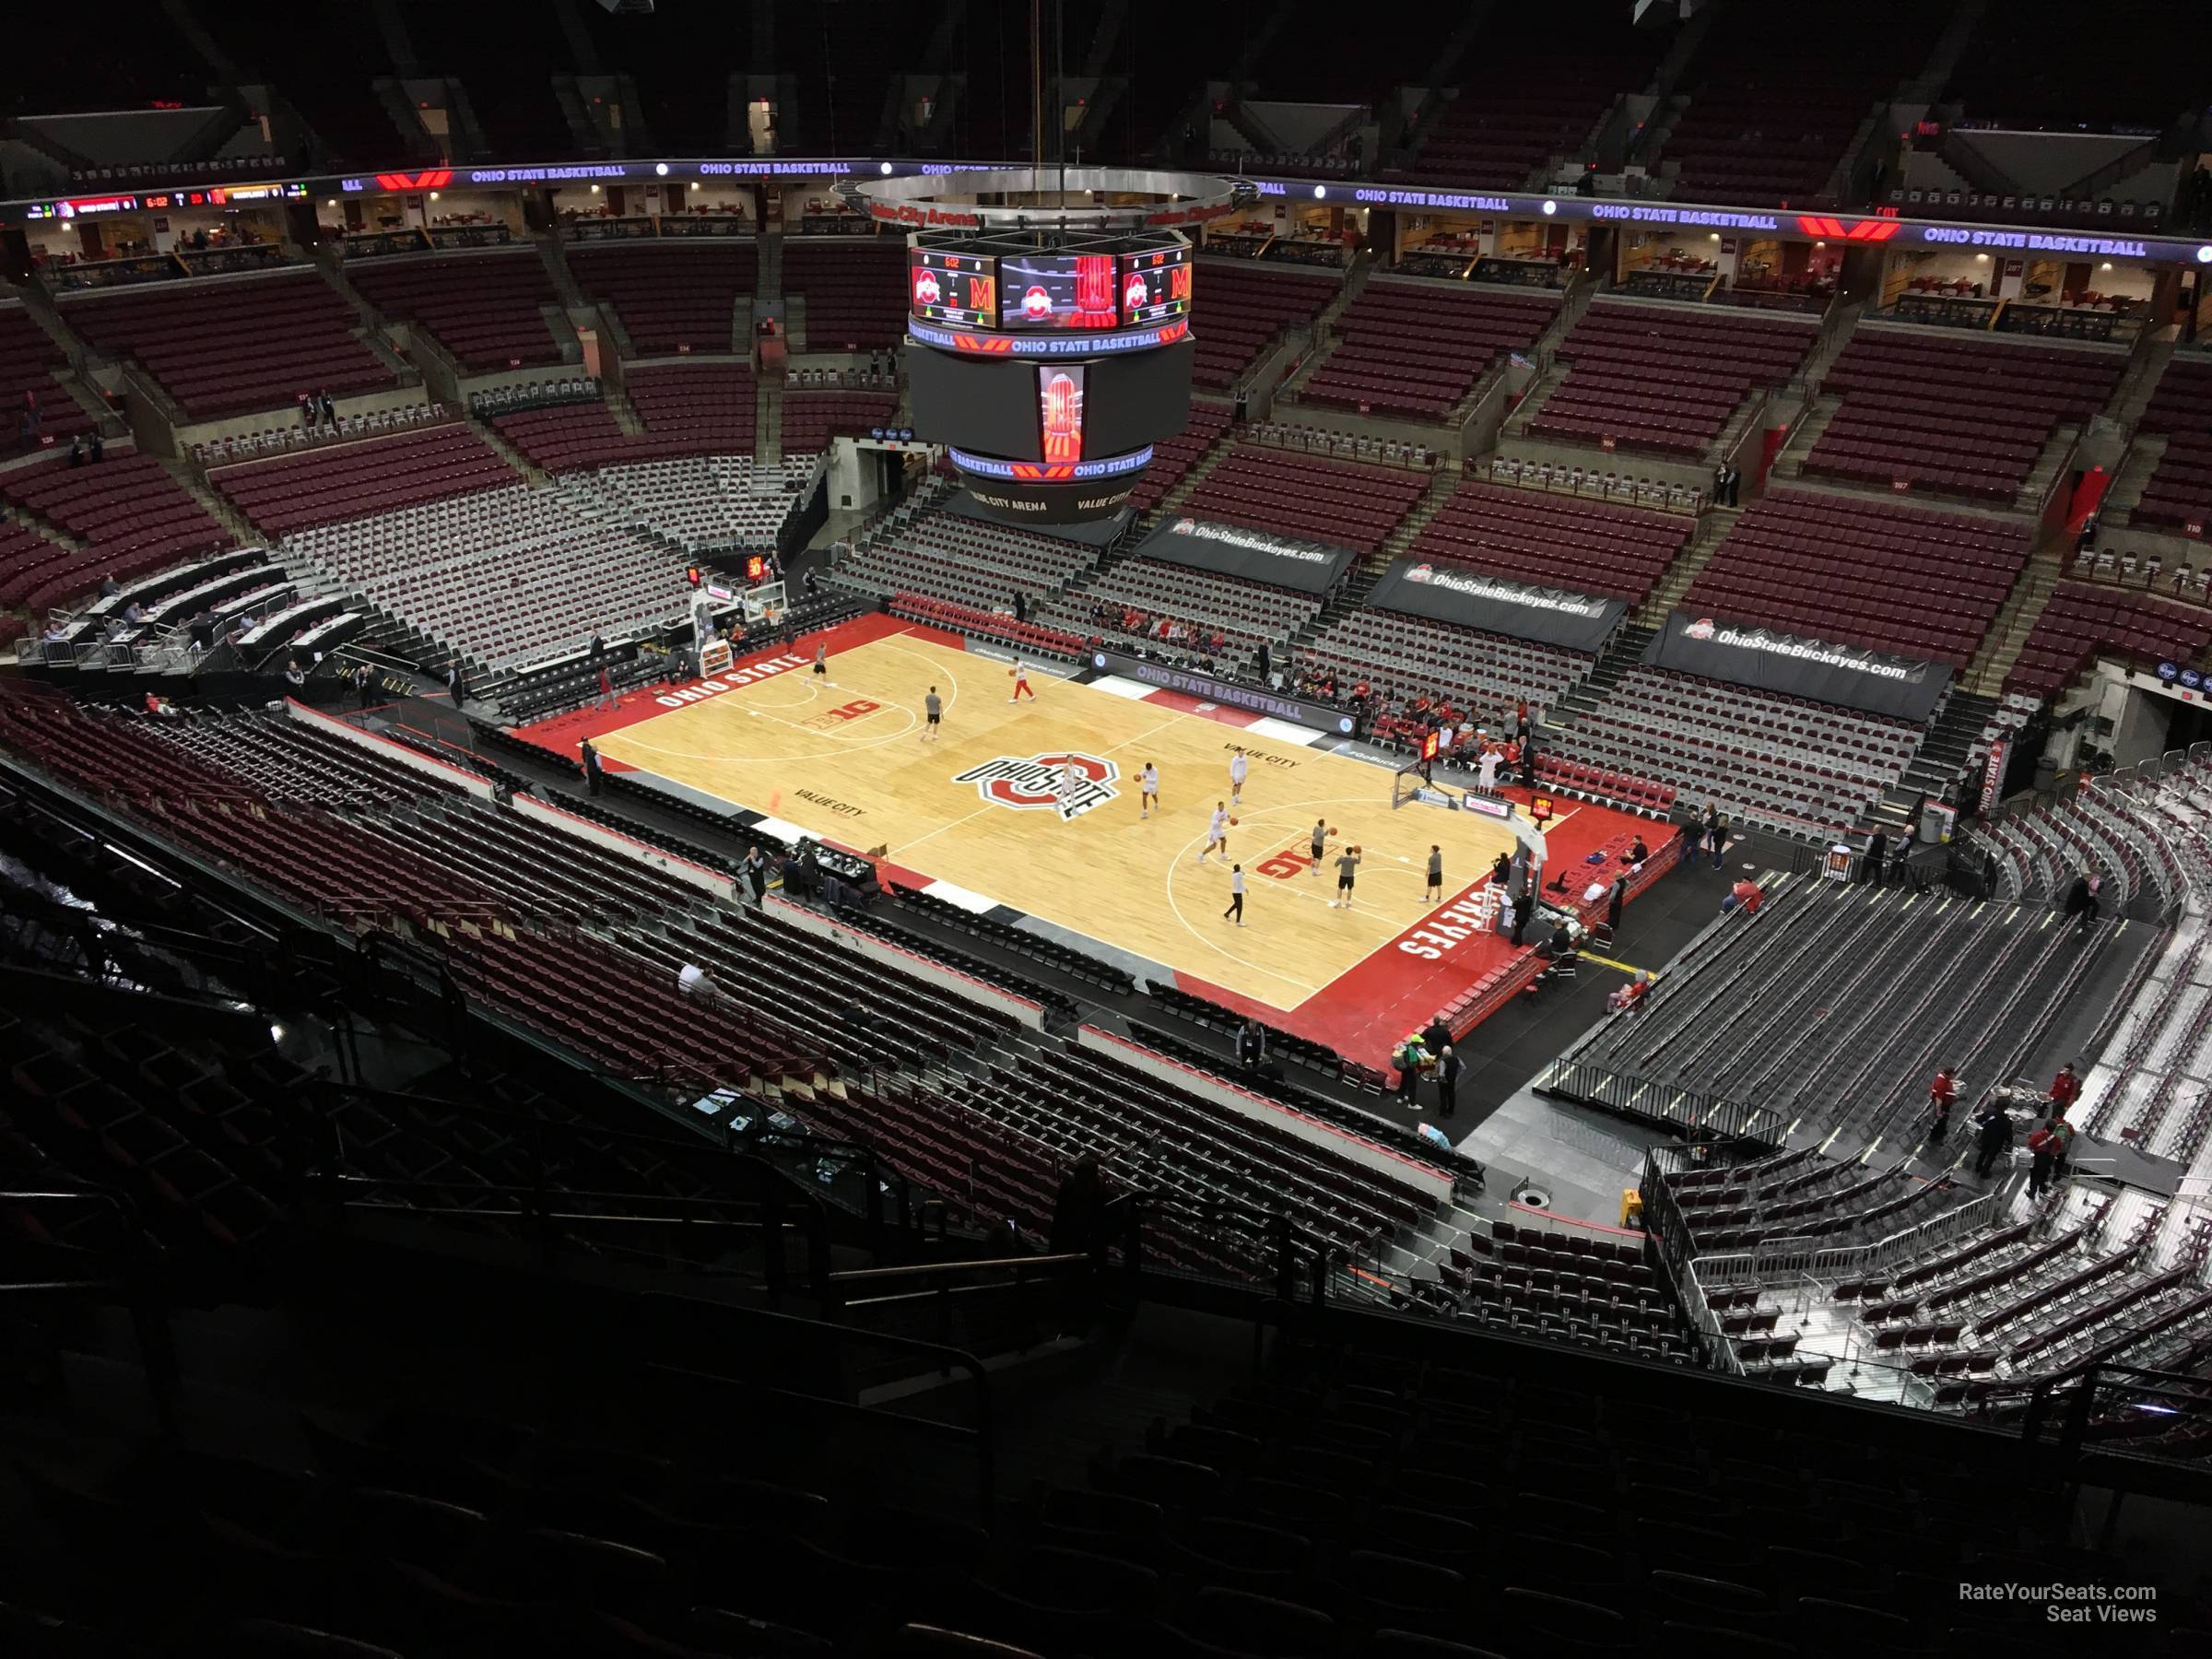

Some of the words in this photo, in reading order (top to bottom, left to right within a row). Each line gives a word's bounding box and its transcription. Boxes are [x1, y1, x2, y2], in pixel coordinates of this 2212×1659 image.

[472, 171, 505, 182] OHIO
[508, 170, 546, 180] STATE
[547, 166, 626, 179] BASKETBALL
[700, 164, 731, 174] OHIO
[735, 163, 771, 174] STATE
[773, 163, 851, 173] BASKETBALL
[922, 165, 952, 174] OHIO
[1356, 189, 1386, 202] OHIO
[1389, 192, 1425, 205] STATE
[1429, 194, 1509, 210] BASKETBALL
[1593, 205, 1630, 218] OHIO
[1632, 207, 1677, 222] STATE
[1679, 211, 1777, 229] BASKETBALL
[1924, 228, 1970, 243] OHIO
[1971, 232, 2025, 248] STATE
[2029, 235, 2146, 256] BASKETBALL
[1011, 341, 1047, 352] OHIO
[1049, 341, 1089, 351] STATE
[1092, 331, 1160, 351] BASKETBALL
[958, 454, 1014, 477] BASKETBALL
[1074, 463, 1105, 476] OHIO
[1107, 457, 1135, 473] STATE
[1011, 500, 1047, 512] ARENA
[1077, 497, 1110, 510] VALUE
[2187, 524, 2201, 532] 110
[1195, 526, 1324, 562] OhioStateBuckeyes.com
[1433, 574, 1589, 615] OhioStateBuckeyes.com
[1717, 630, 1908, 680] OhioStateBuckeyes.com
[655, 680, 729, 708] OHIO
[727, 653, 811, 684] STATE
[1137, 665, 1171, 683] OHIO
[1172, 675, 1212, 695] STATE
[1214, 686, 1302, 720] BASKETBALL
[1265, 756, 1302, 769] CITY
[1347, 750, 1402, 768] #GoBucks
[1985, 754, 2000, 786] STATE
[794, 788, 837, 807] VALUE
[831, 803, 867, 817] CITY
